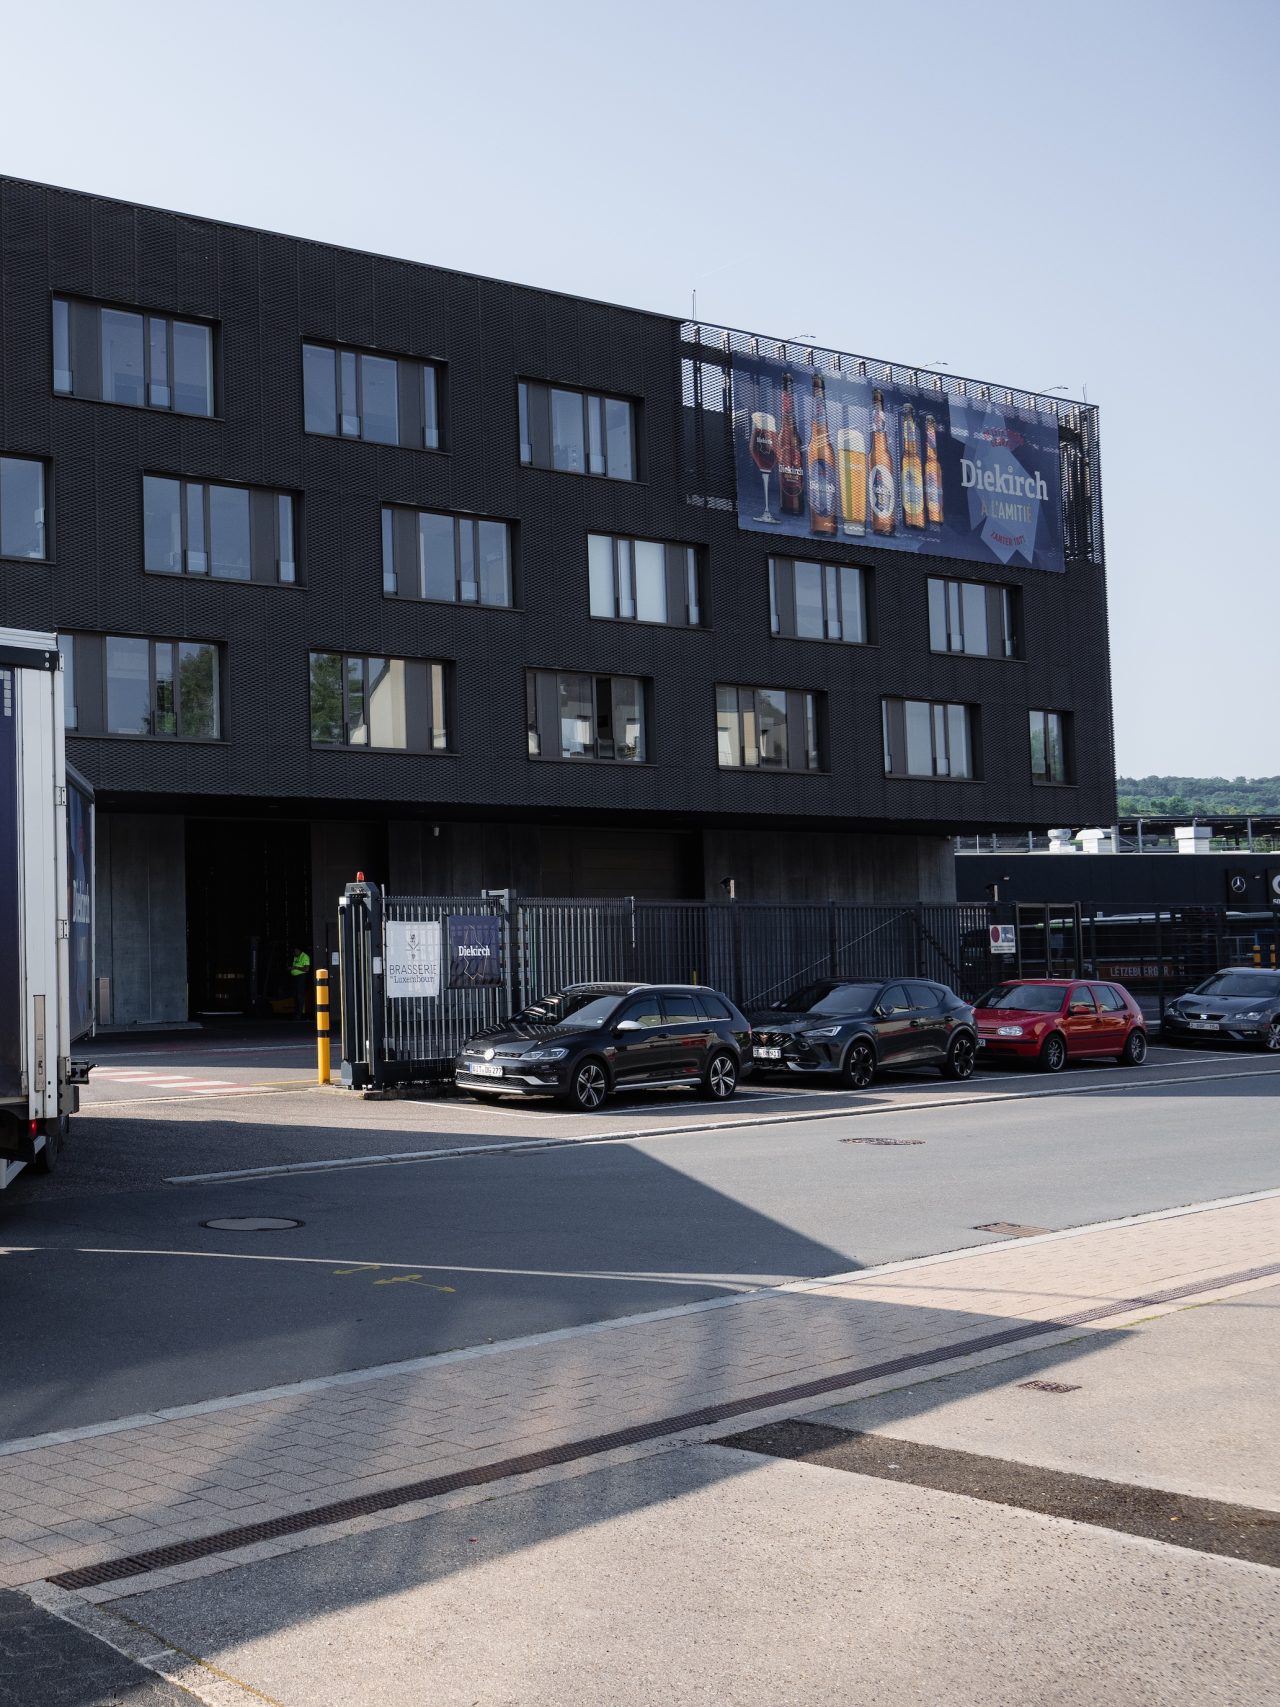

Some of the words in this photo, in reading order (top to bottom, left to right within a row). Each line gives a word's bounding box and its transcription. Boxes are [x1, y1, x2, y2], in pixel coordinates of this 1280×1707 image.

[960, 459, 1048, 500] Diekirch
[457, 945, 491, 957] Diekirch
[389, 964, 437, 975] BRASSERIE
